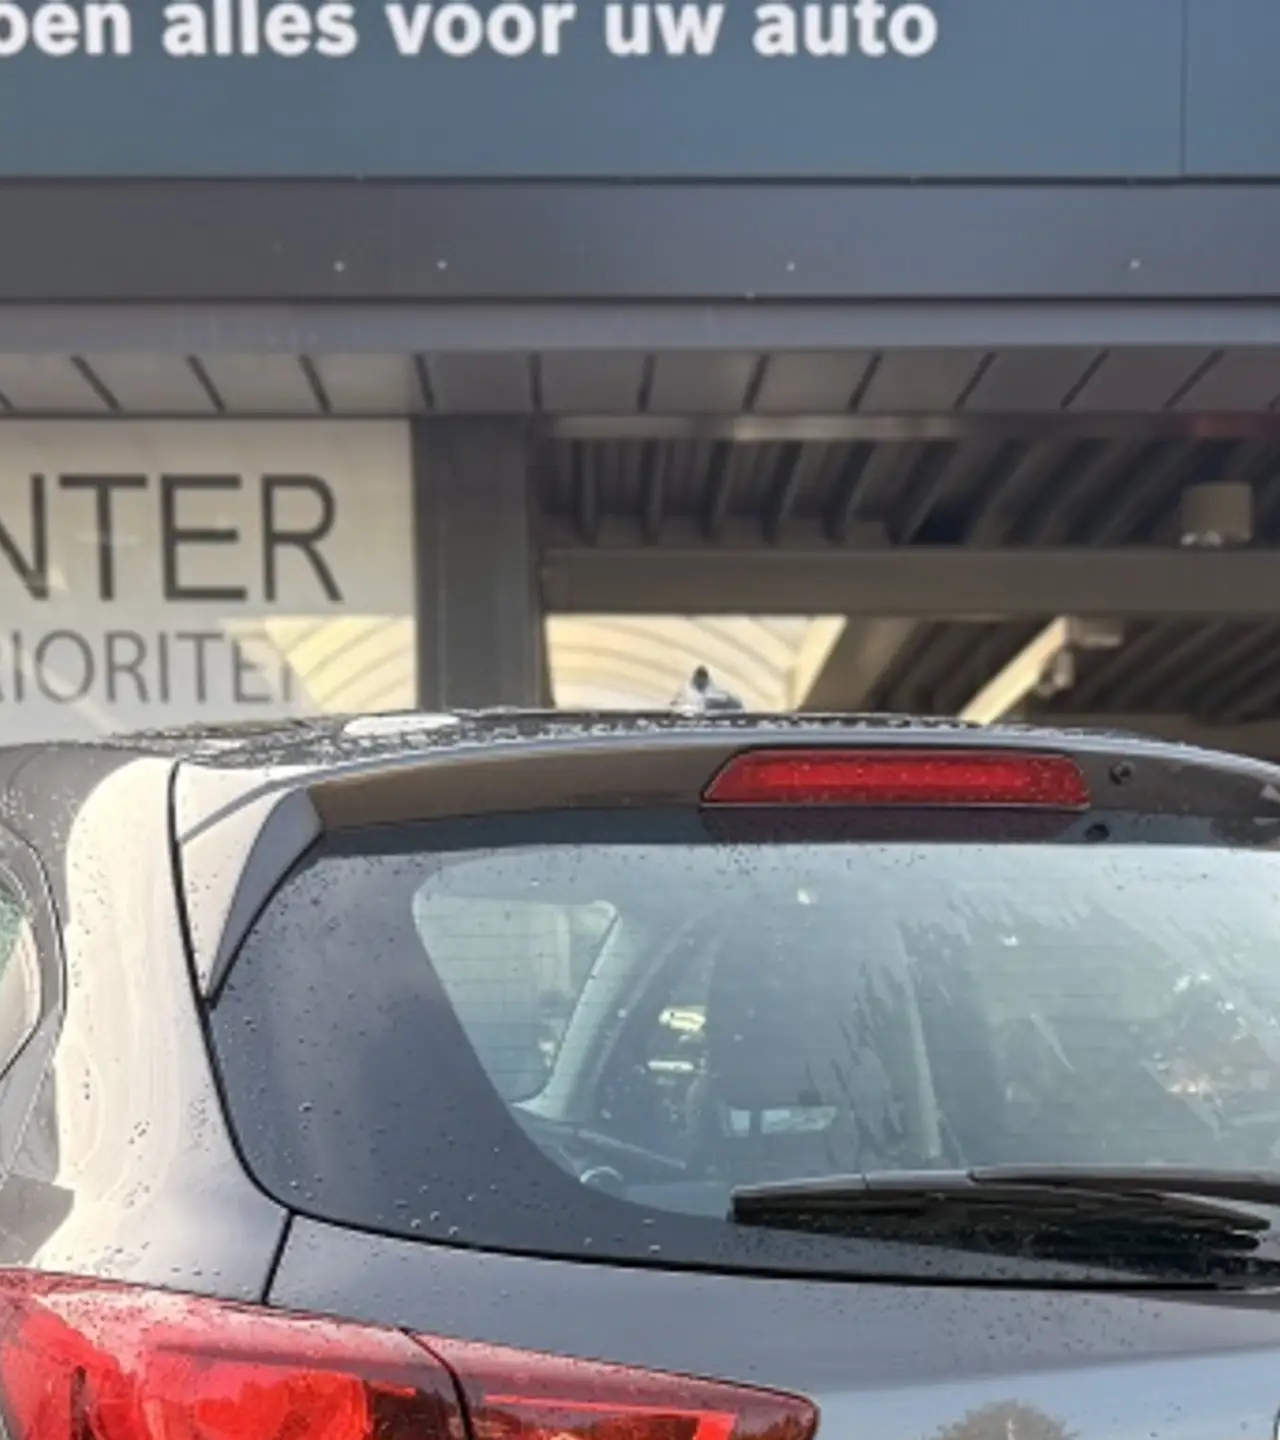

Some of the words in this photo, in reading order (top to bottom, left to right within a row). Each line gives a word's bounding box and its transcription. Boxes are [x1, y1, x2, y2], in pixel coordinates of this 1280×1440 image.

[161, 0, 358, 56] alles
[385, 2, 576, 56] voor
[605, 2, 724, 56] uw
[752, 1, 938, 57] auto
